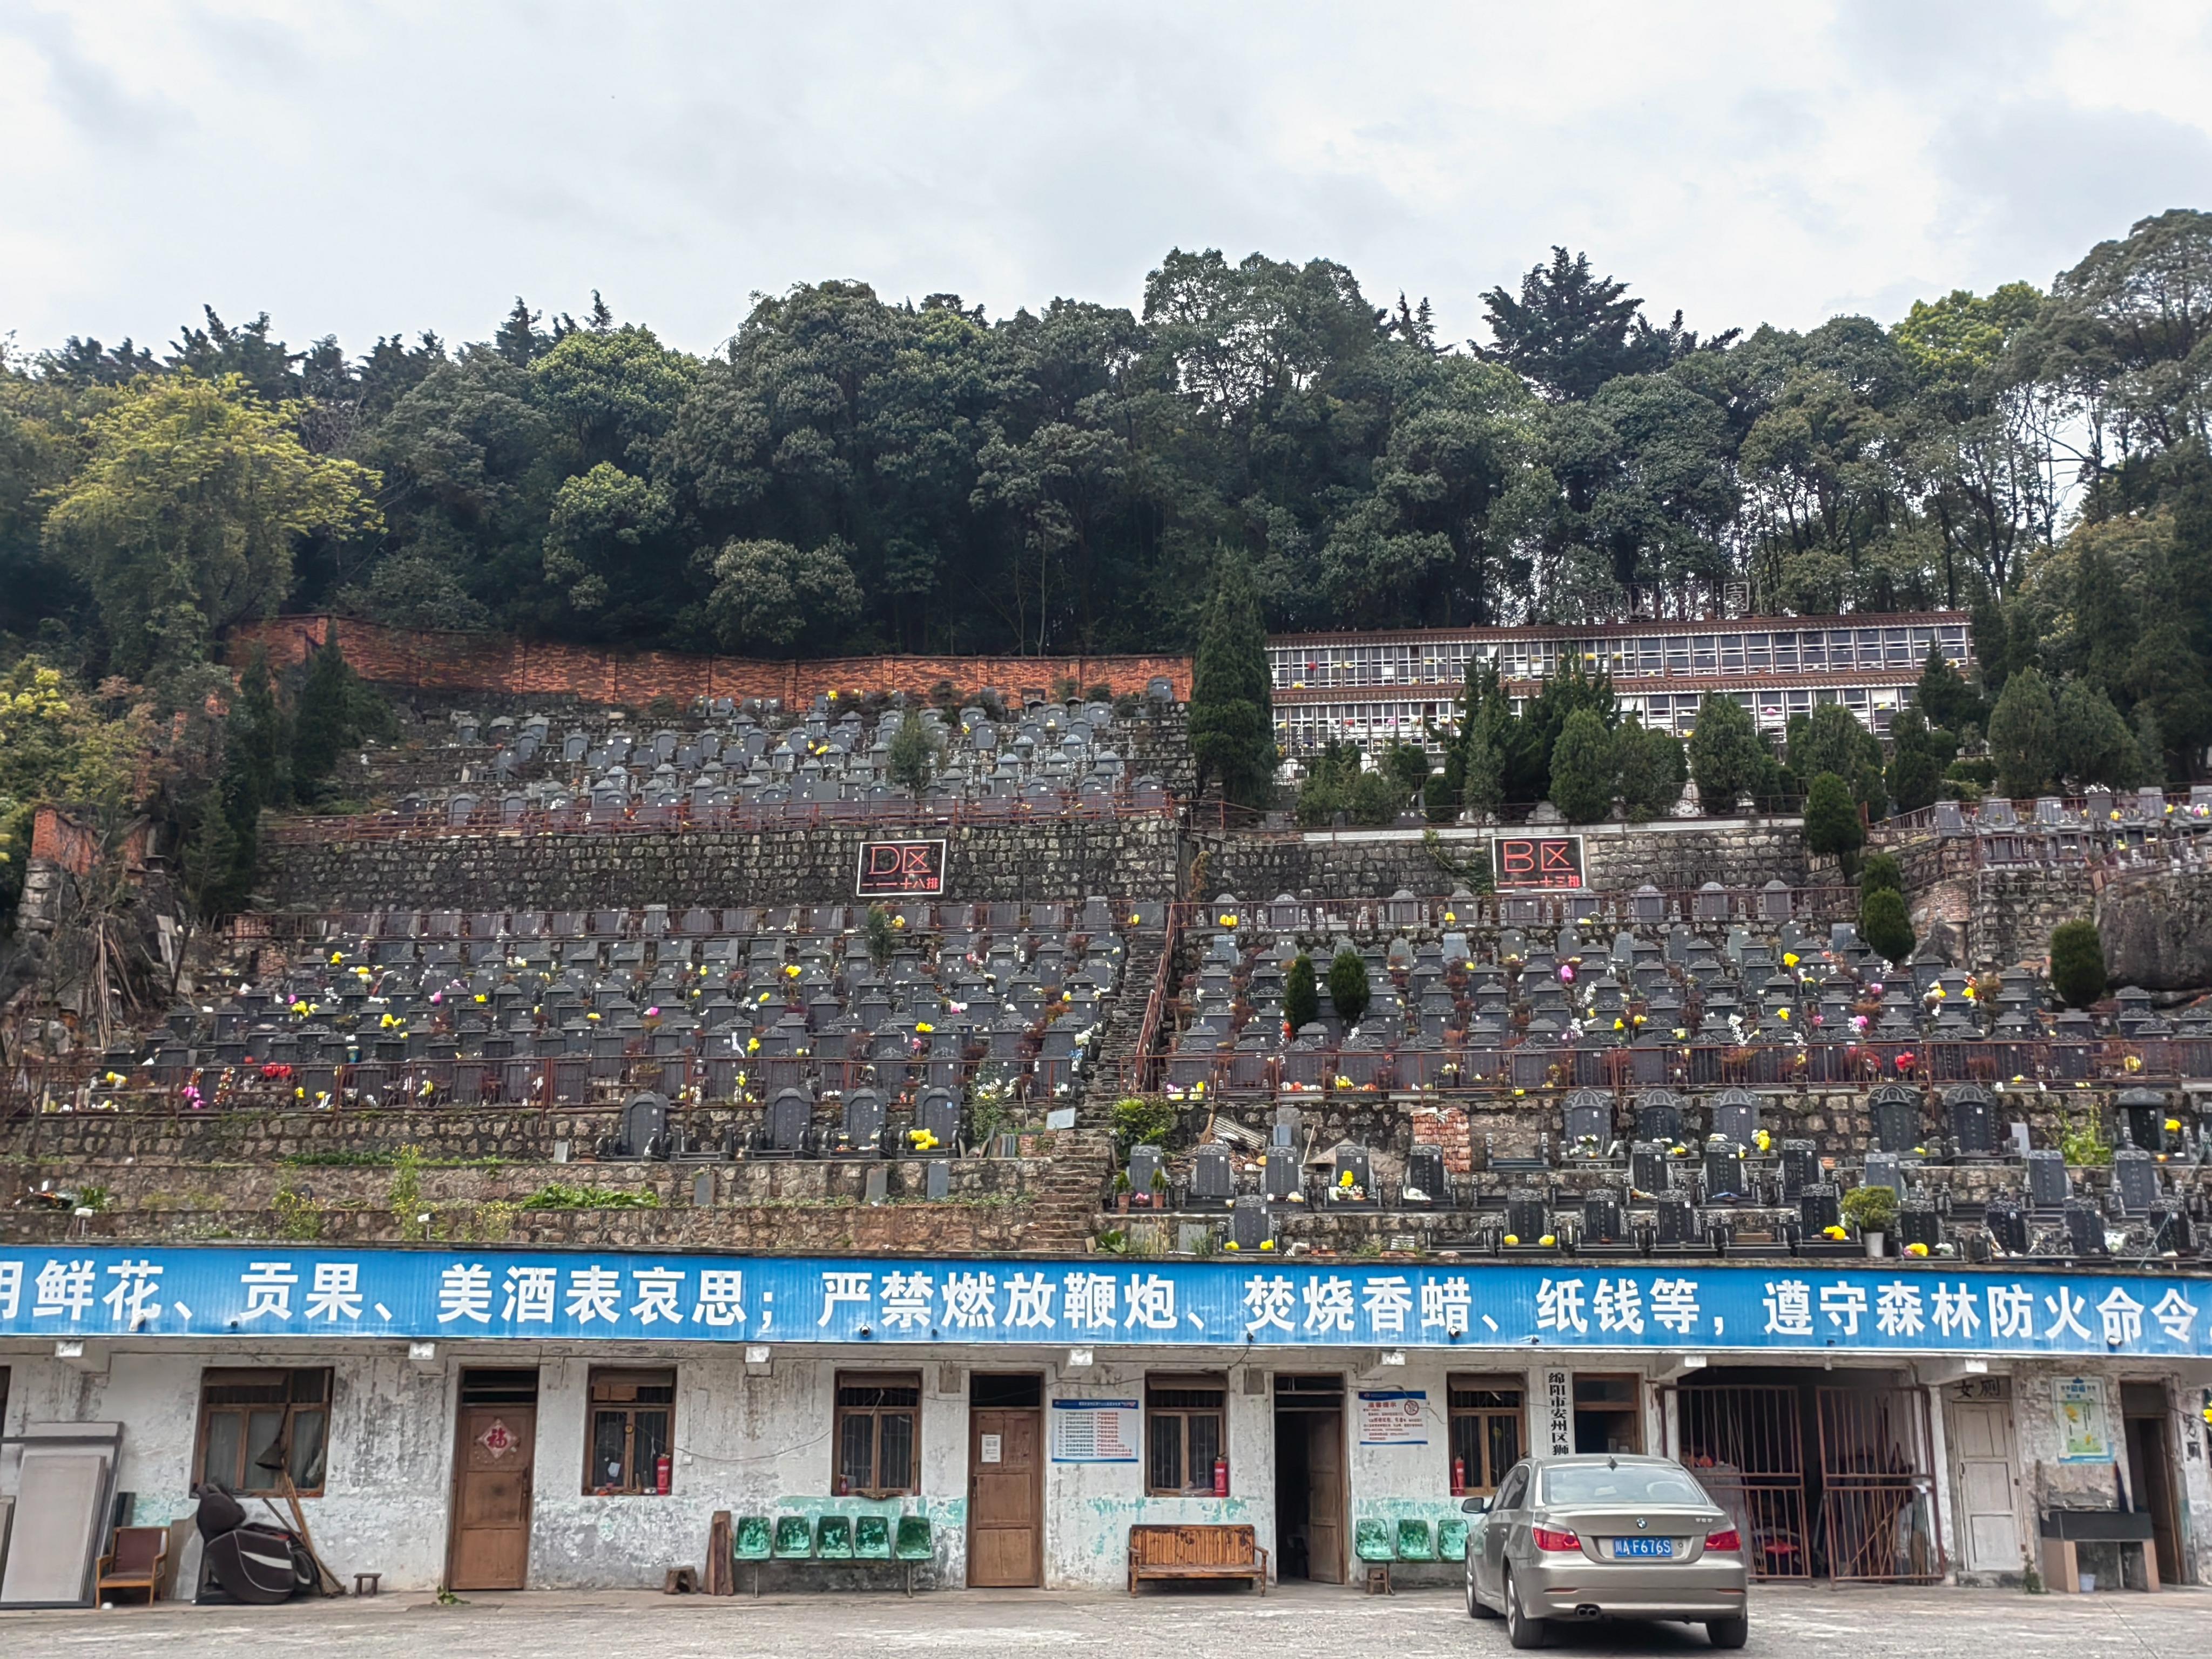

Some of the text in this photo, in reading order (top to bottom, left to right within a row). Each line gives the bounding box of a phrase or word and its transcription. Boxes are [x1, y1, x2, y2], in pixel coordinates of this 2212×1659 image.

[868, 846, 932, 874] D区
[1503, 841, 1574, 872] B区
[0, 1259, 2212, 1345] 鲜花、贡果、美酒表哀思；严禁燃放鞭炮、焚烧香蜡、纸钱等，遵守森林防火命令
[487, 1427, 508, 1448] 福
